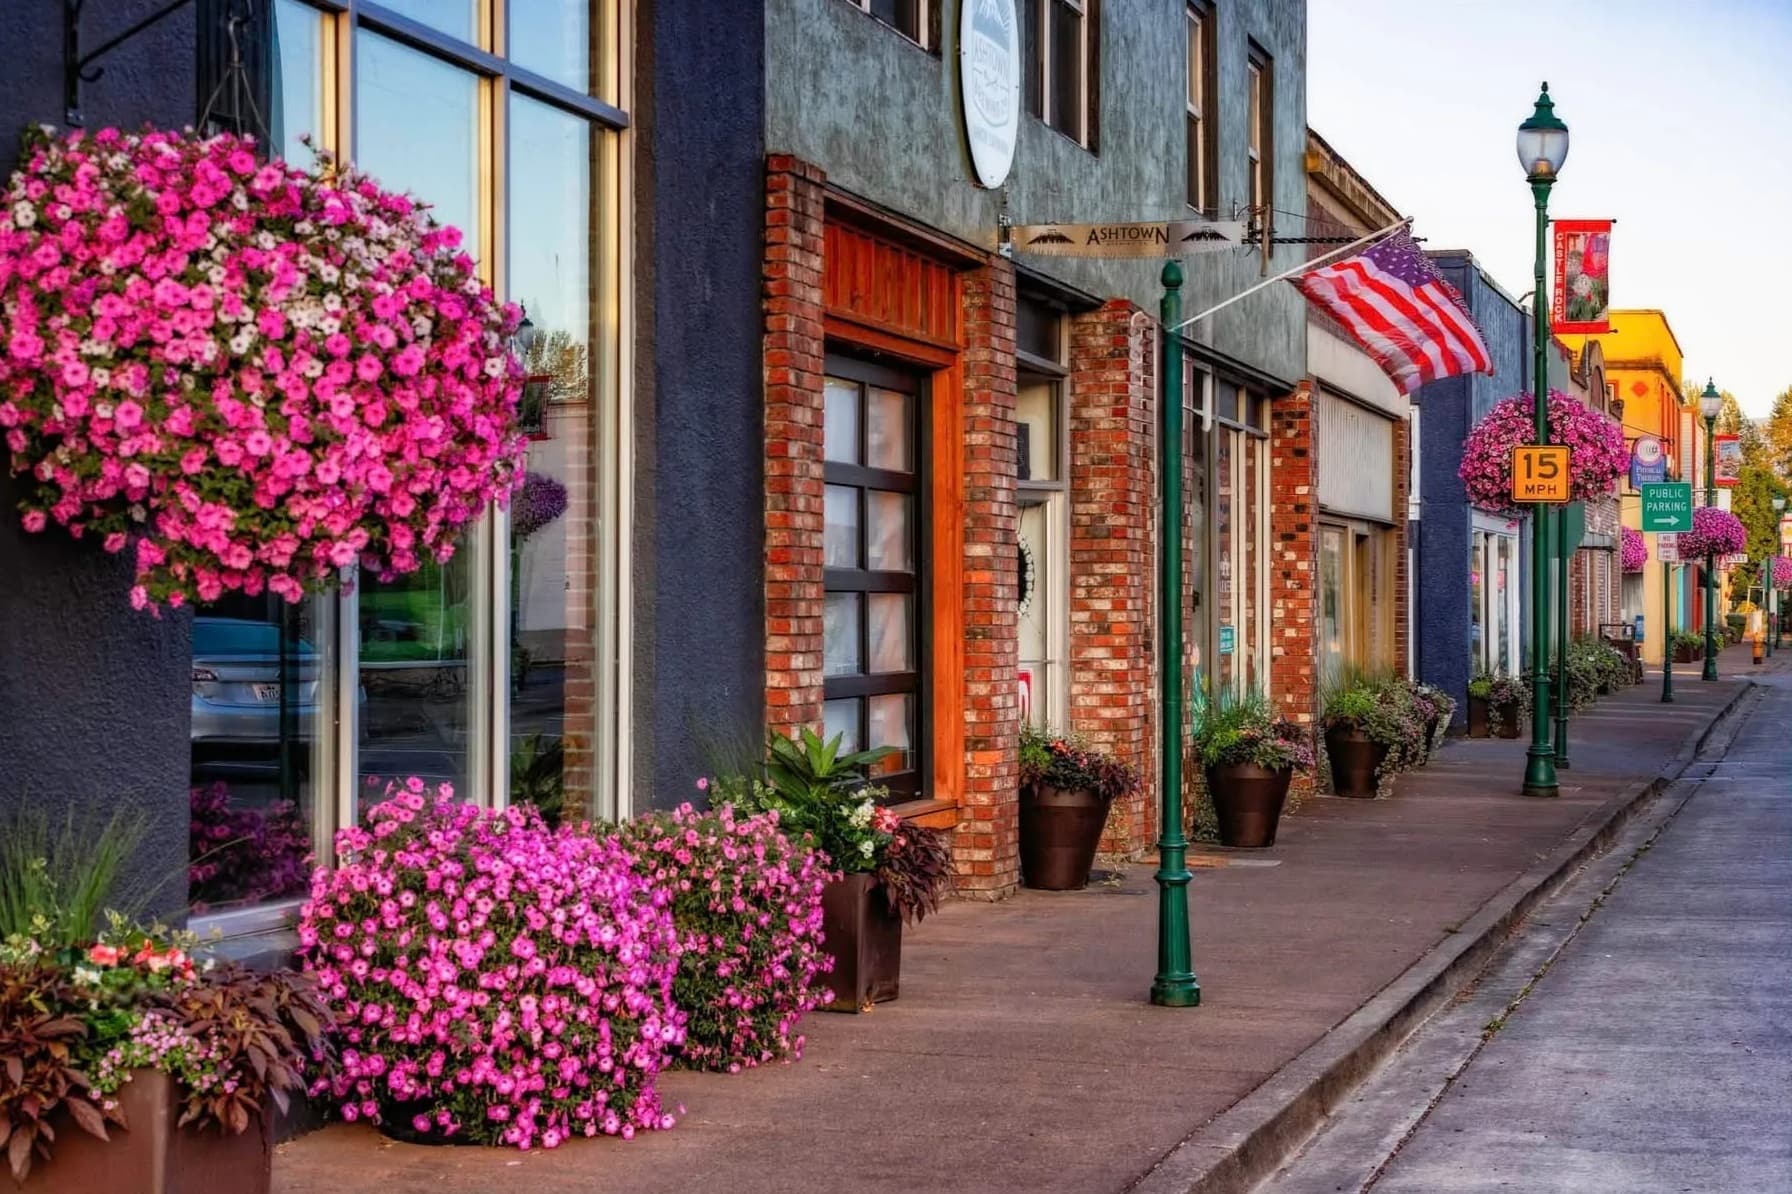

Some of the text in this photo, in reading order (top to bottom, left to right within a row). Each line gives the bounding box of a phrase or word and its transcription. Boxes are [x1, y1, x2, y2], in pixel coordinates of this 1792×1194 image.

[1086, 226, 1170, 246] ASHTOWN
[1555, 232, 1564, 323] CASTLE ROCK
[1523, 453, 1559, 479] 15
[1525, 484, 1557, 495] MPH
[1649, 488, 1684, 499] PUBLIC
[1646, 502, 1687, 512] PARKING
